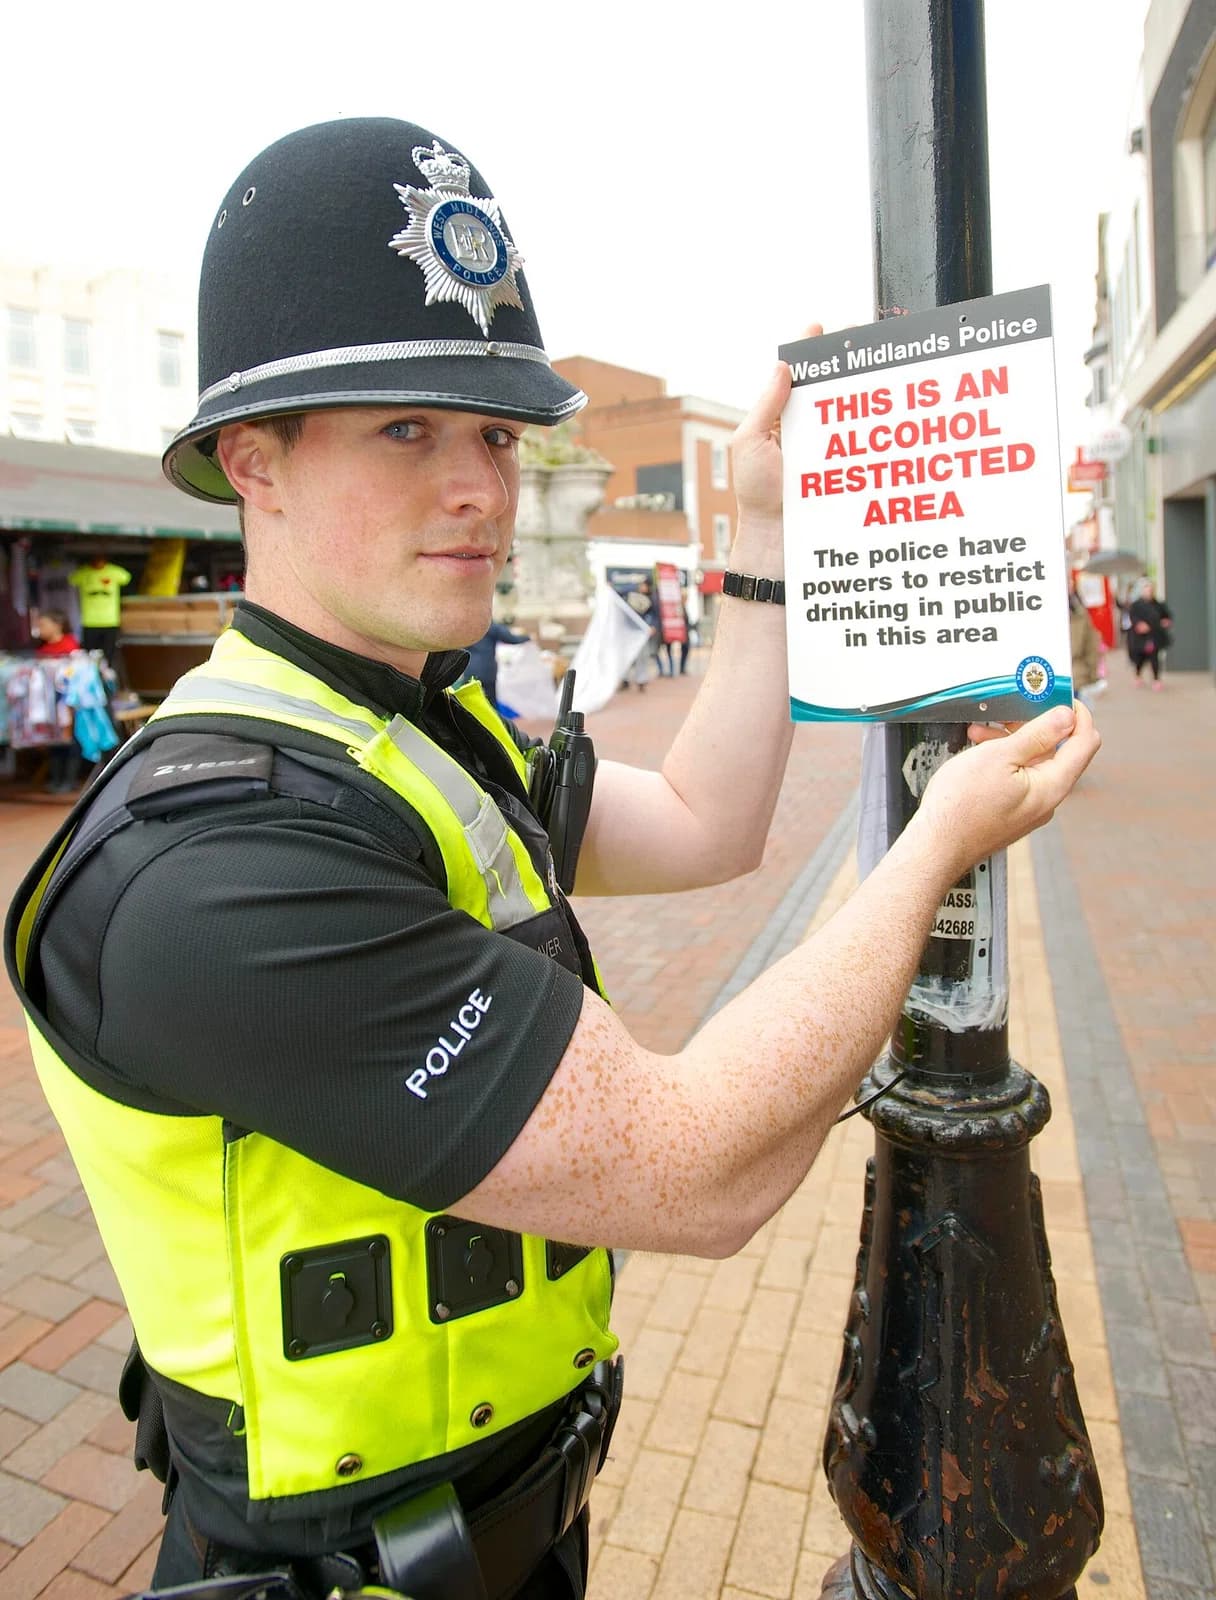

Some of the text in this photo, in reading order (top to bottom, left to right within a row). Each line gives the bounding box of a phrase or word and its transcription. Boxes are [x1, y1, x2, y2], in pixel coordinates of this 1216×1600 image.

[432, 203, 505, 247] WEST MIDLANDS
[452, 262, 503, 284] POLICE
[789, 316, 1038, 382] West Midlands Police
[814, 366, 1009, 425] THIS IS AN
[824, 408, 1001, 460] ALCOHOL
[800, 443, 1036, 498] RESTRICTED
[863, 491, 965, 527] AREA
[814, 536, 1027, 569] The police have
[802, 561, 1046, 600] powers to restrict
[806, 591, 1043, 622] drinking in public
[845, 626, 999, 648] in this area
[405, 987, 493, 1099] POLICE
